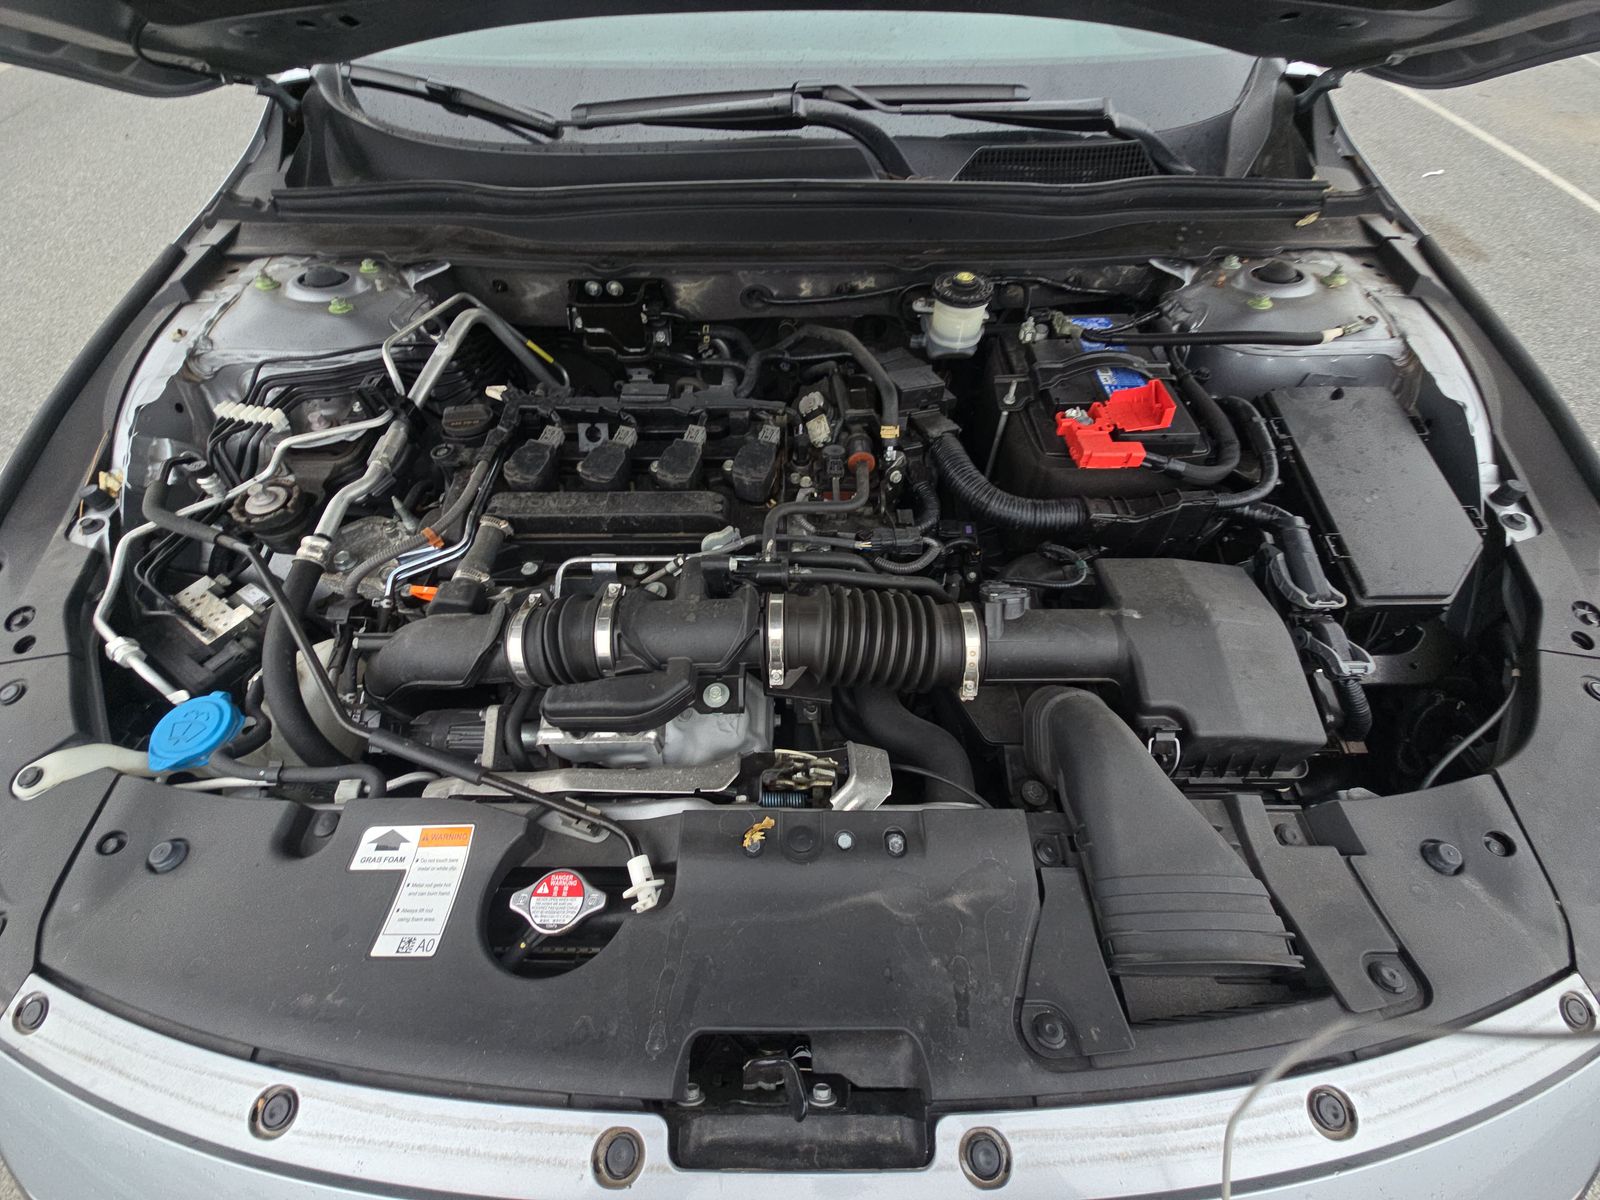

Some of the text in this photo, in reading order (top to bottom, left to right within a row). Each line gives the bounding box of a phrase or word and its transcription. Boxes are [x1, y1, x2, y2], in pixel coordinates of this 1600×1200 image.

[431, 832, 468, 841] WARNING
[360, 856, 381, 864] GRAB
[415, 939, 435, 953] A0
